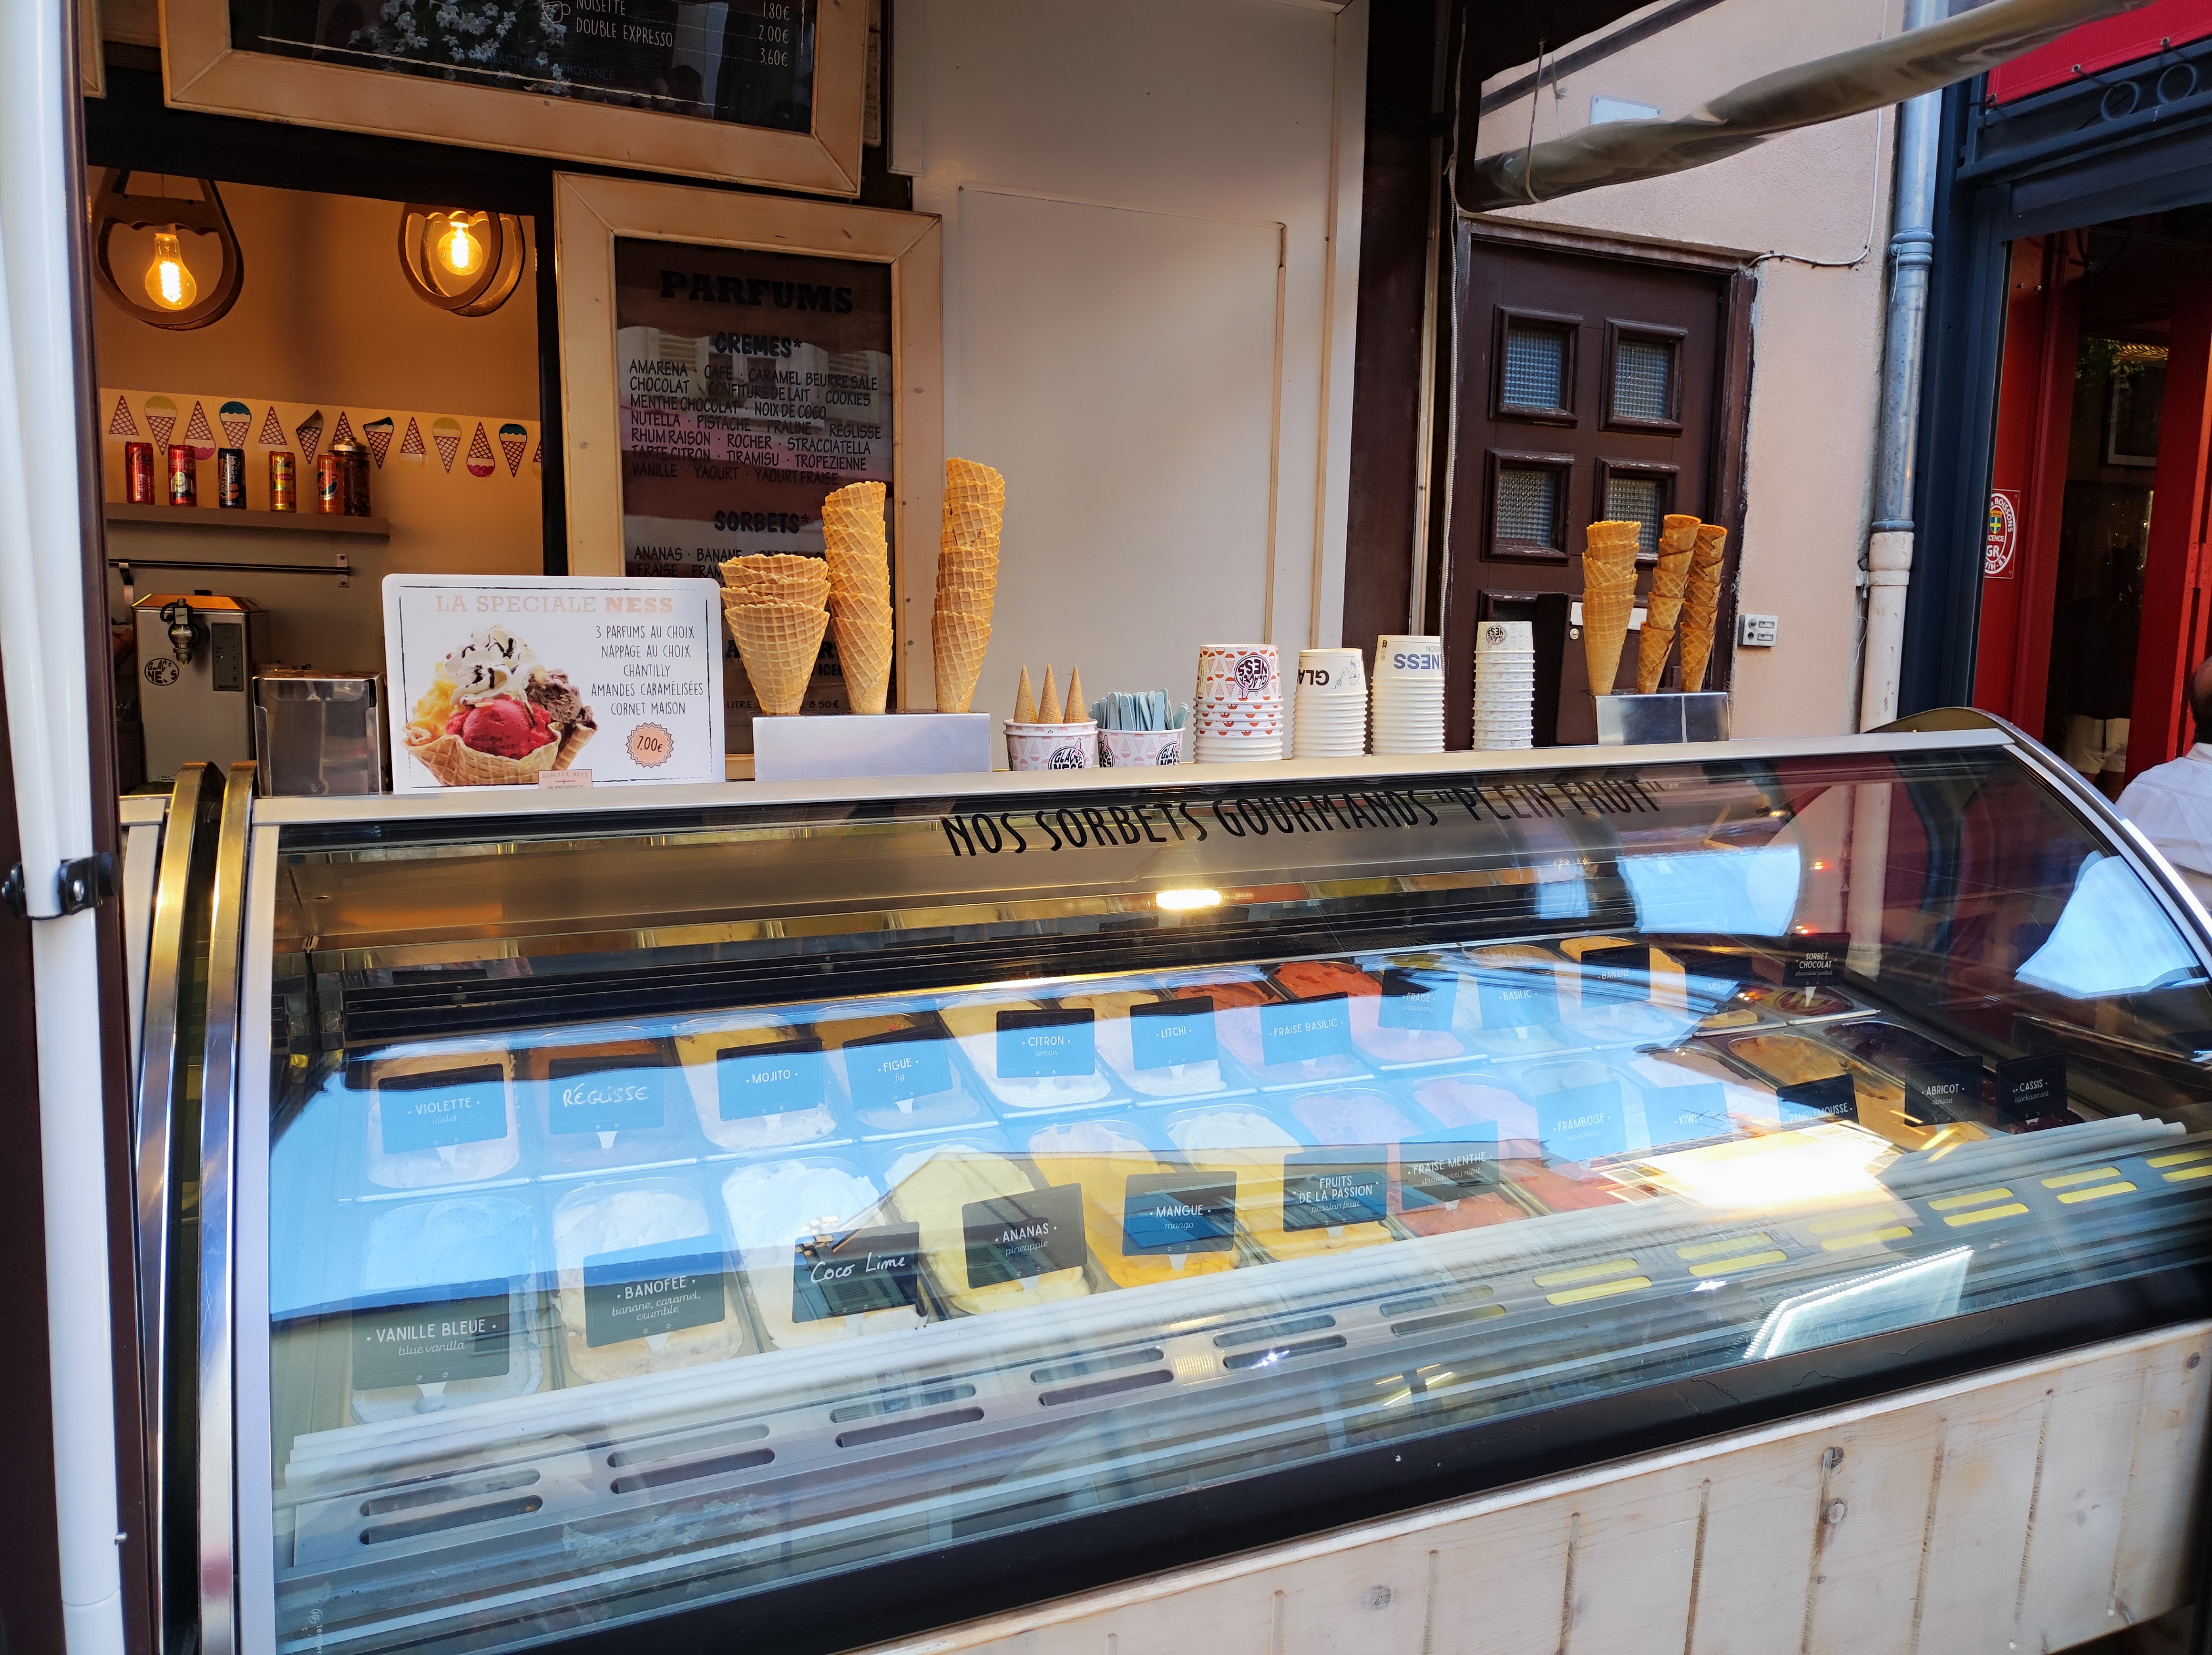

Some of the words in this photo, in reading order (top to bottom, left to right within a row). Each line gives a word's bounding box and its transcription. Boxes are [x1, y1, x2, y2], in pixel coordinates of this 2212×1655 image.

[576, 0, 625, 15] NOISETTE
[576, 17, 617, 38] DOUBLE
[623, 25, 673, 47] EXPRESSO
[660, 270, 852, 314] PARFUMS
[630, 359, 687, 377] AMARENA
[705, 365, 733, 380] CAFE
[749, 368, 801, 385] CARAMEL
[806, 372, 849, 389] BEURRE
[851, 377, 878, 390] SALE
[630, 377, 689, 394] CHOCOLAT
[709, 382, 769, 399] CONFITURE
[771, 387, 785, 400] DE
[788, 388, 810, 402] LAIT
[825, 390, 870, 406] COOKIES
[631, 394, 678, 410] MENTHE
[680, 397, 737, 414] CHOCOLAT
[755, 404, 779, 417] NOIX
[781, 405, 795, 418] DE
[798, 406, 826, 419] COCO
[631, 413, 680, 427] NUTELLA
[697, 415, 750, 431] PISTACHE
[767, 419, 812, 435] PRALINE
[830, 423, 881, 439] REGLISSE
[632, 428, 666, 443] RHUM
[669, 430, 711, 445] RAISON
[727, 433, 772, 449] ROCHER
[788, 437, 870, 455] STRACCIATELLA
[632, 445, 667, 460] TARTE
[671, 447, 710, 461] CITRON
[727, 450, 779, 466] TIRAMISU
[795, 454, 867, 470] TROPEZIENNE
[632, 462, 677, 477] VANILLE
[694, 466, 739, 480] YAOURT
[755, 468, 797, 483] YAOURT
[800, 470, 838, 485] FRAISE
[1995, 497, 2013, 532] BOISSONS
[635, 546, 682, 561] ANANAS
[638, 563, 677, 577] FRAISE
[436, 595, 468, 612] LA
[476, 596, 596, 613] SPECIALE
[604, 597, 673, 613] NESS
[596, 626, 601, 637] 3
[606, 626, 645, 640] PARFUMS
[650, 626, 662, 639] AU
[667, 626, 695, 639] CHOIX
[601, 645, 641, 658] NAPPAGE
[646, 645, 658, 658] AU
[663, 645, 691, 658] CHOIX
[1238, 658, 1268, 676] NESS
[1393, 653, 1440, 670] NESS
[624, 664, 670, 677] CHANTILLY
[591, 683, 635, 697] AMANDES
[640, 680, 703, 696] CARAMÉLISÉES
[611, 702, 645, 715] CORNET
[651, 702, 686, 715] MAISON
[940, 812, 1027, 856] NOS
[1035, 802, 1208, 852] SORBETS
[1212, 788, 1438, 838] GOURMANDS
[1799, 960, 1832, 969] CHOCOLAT
[1602, 969, 1629, 980] BANANE
[1709, 980, 1731, 991] MELON
[1406, 992, 1430, 1003] FRAISE
[1503, 990, 1532, 1001] BASILIC
[1402, 1004, 1433, 1013] strawberry
[1160, 1026, 1186, 1038] LITCHI
[1274, 1024, 1302, 1037] FRAISE
[1305, 1018, 1337, 1032] BASILIC
[1028, 1036, 1065, 1046] CITRON
[1034, 1048, 1058, 1057] lemon
[883, 1057, 912, 1073] FIGUE
[752, 1070, 791, 1084] MOJITO
[895, 1073, 906, 1082] fig
[1926, 1083, 1959, 1096] ABRICOT
[2019, 1079, 2044, 1093] CASSIS
[1932, 1097, 1954, 1106] apricot
[2015, 1091, 2049, 1103] blackcurrant
[415, 1097, 472, 1115] VIOLETTE
[432, 1114, 457, 1124] violet
[1557, 1113, 1605, 1132] FRAMBOISE
[1566, 1129, 1599, 1142] raspberry
[1413, 1161, 1444, 1176] FRAISE
[1448, 1152, 1486, 1168] MENTHE
[1319, 1175, 1352, 1190] FRUITS
[1421, 1171, 1463, 1184] strawberry
[1464, 1166, 1480, 1175] mint
[1299, 1190, 1312, 1204] DE
[1315, 1188, 1328, 1202] LA
[1332, 1184, 1373, 1200] PASSION
[1156, 1204, 1204, 1217] MANGUE
[1311, 1202, 1342, 1215] passion
[1342, 1200, 1361, 1211] fruit
[1002, 1222, 1049, 1243] ANANAS
[1165, 1221, 1195, 1230] mango
[1005, 1239, 1049, 1257] pineapple
[811, 1261, 855, 1283] Coco
[865, 1251, 906, 1272] Lime
[625, 1275, 686, 1300] BANOFEE
[612, 1300, 653, 1316] banane,
[656, 1289, 701, 1307] caramel,
[636, 1305, 679, 1321] crumble
[376, 1324, 435, 1343] VANILLE
[441, 1319, 486, 1337] BLEUE
[399, 1344, 423, 1356] blue
[426, 1340, 465, 1353] vanilla
